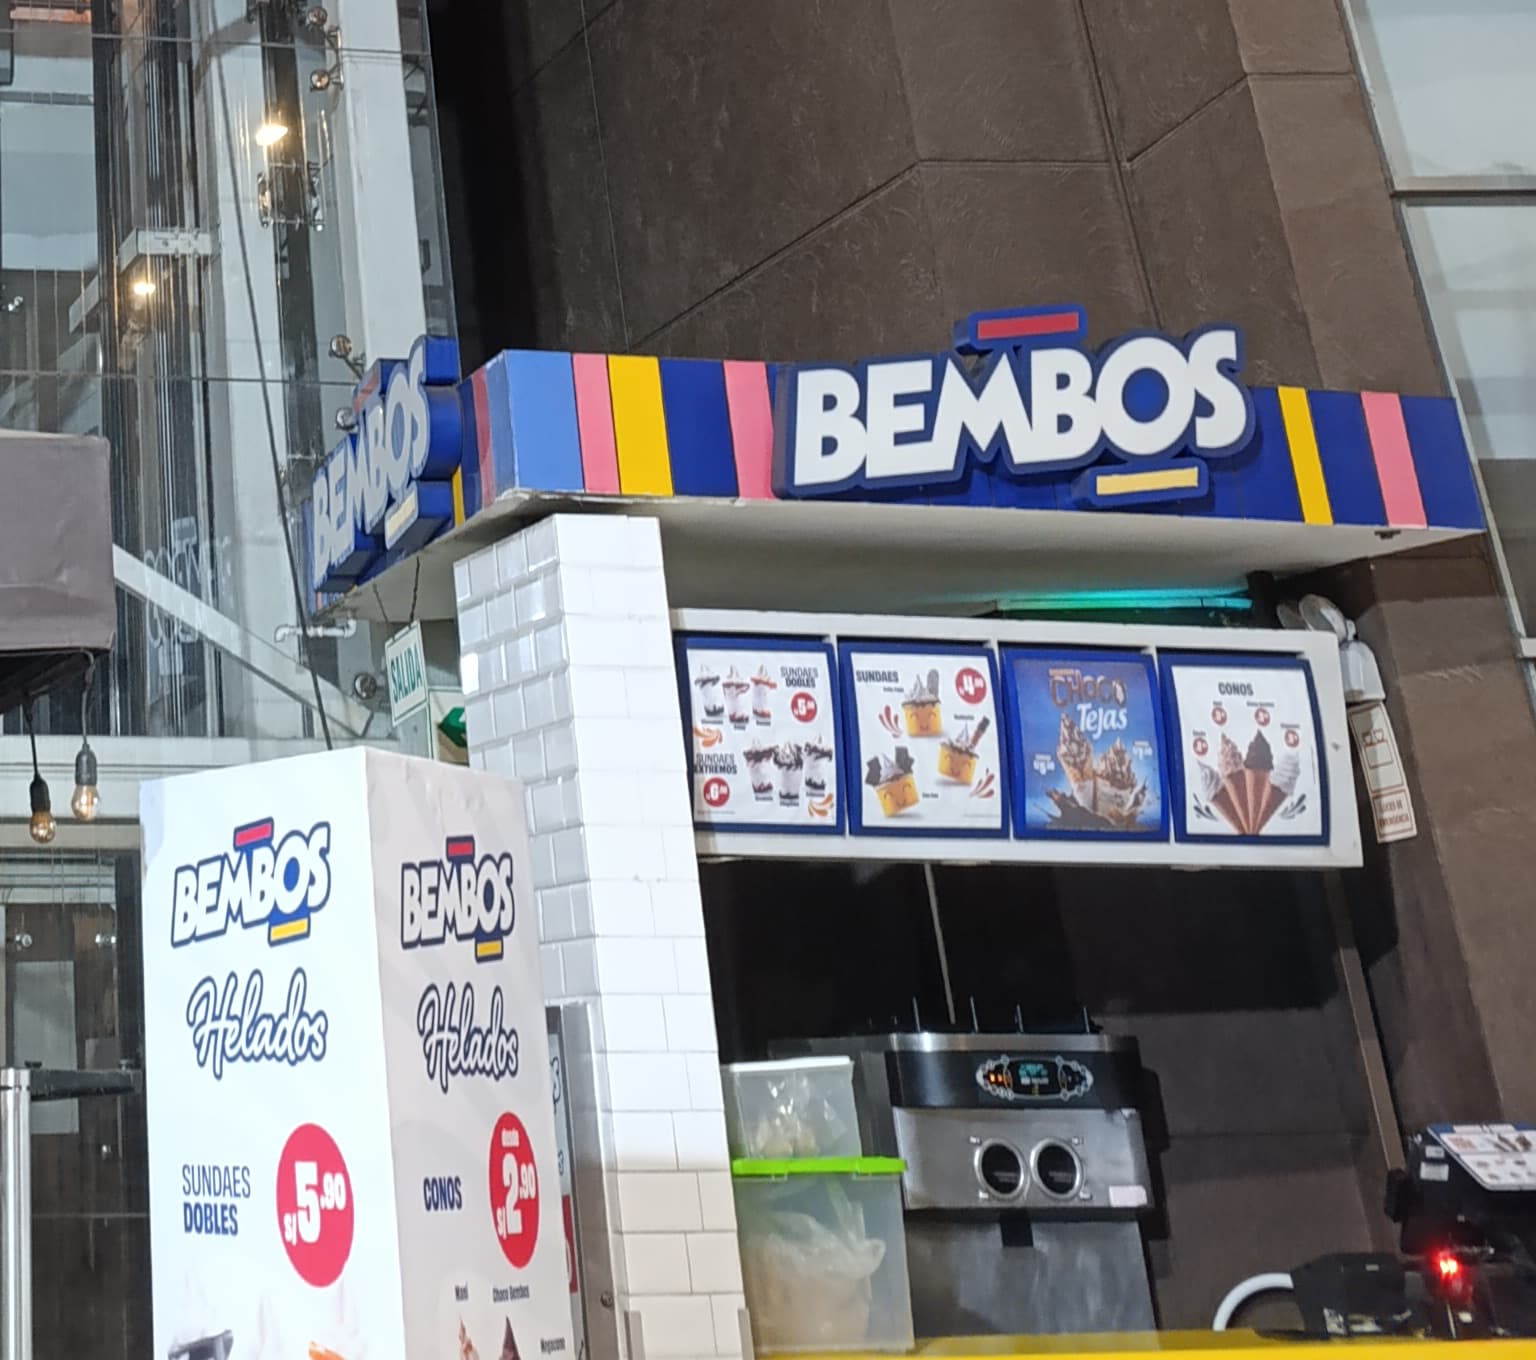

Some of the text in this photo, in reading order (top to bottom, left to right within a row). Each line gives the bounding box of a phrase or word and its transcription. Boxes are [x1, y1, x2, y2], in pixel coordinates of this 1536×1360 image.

[794, 329, 1247, 486] BEMBOS
[314, 342, 428, 589] BEMBOS
[390, 643, 423, 704] SALIDA
[780, 666, 819, 678] SUNDAES
[855, 669, 899, 683] SUNDAES
[1218, 682, 1254, 696] CONOS
[1077, 702, 1128, 740] Tejas
[695, 753, 735, 764] SUNDAES
[171, 821, 332, 949] BEMBOS
[401, 851, 516, 950] BEMBOS
[186, 967, 329, 1081] Helados
[417, 981, 519, 1095] Helados
[182, 1164, 251, 1199] SUNDAES
[423, 1175, 462, 1212] CONOS
[183, 1202, 239, 1236] DOBLES
